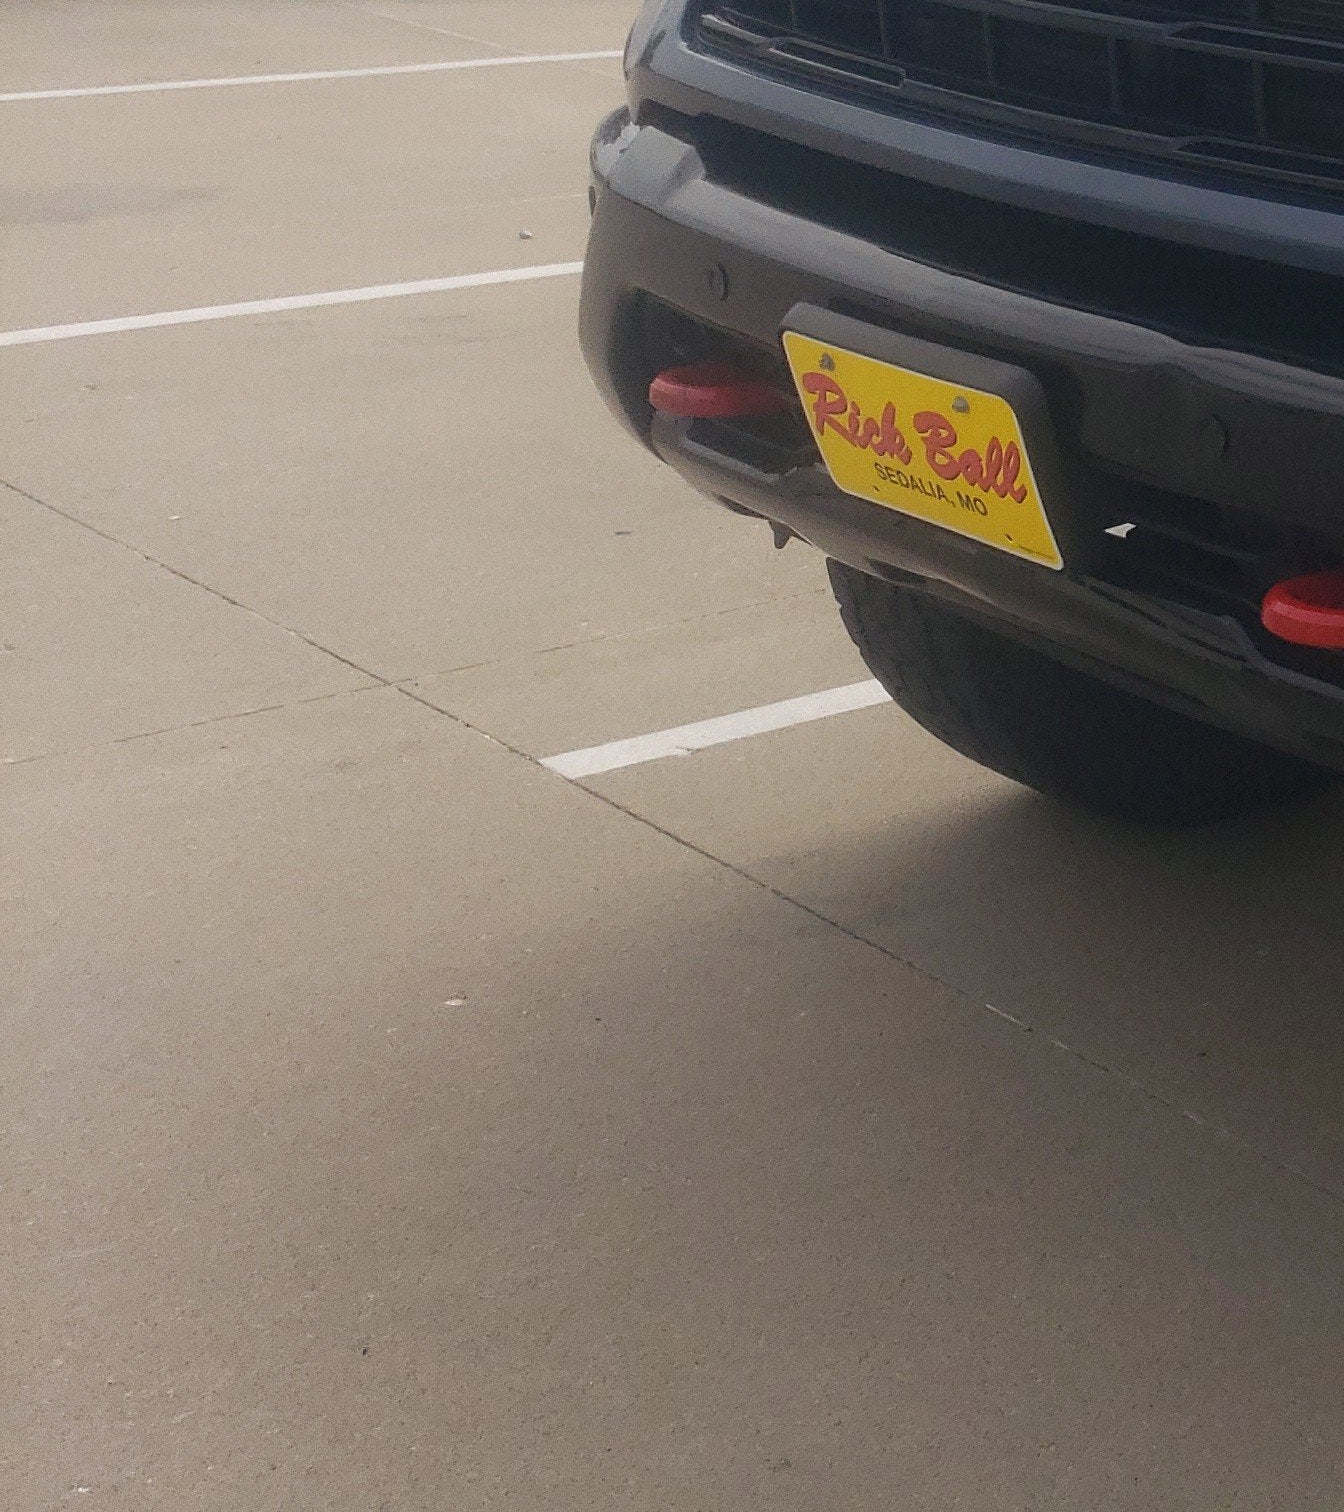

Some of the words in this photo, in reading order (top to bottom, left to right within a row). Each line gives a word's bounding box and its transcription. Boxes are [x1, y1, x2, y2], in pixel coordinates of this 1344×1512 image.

[803, 372, 912, 465] Rick
[913, 411, 1028, 504] Ball
[873, 462, 956, 508] SEDALIA,
[957, 490, 989, 517] MO
